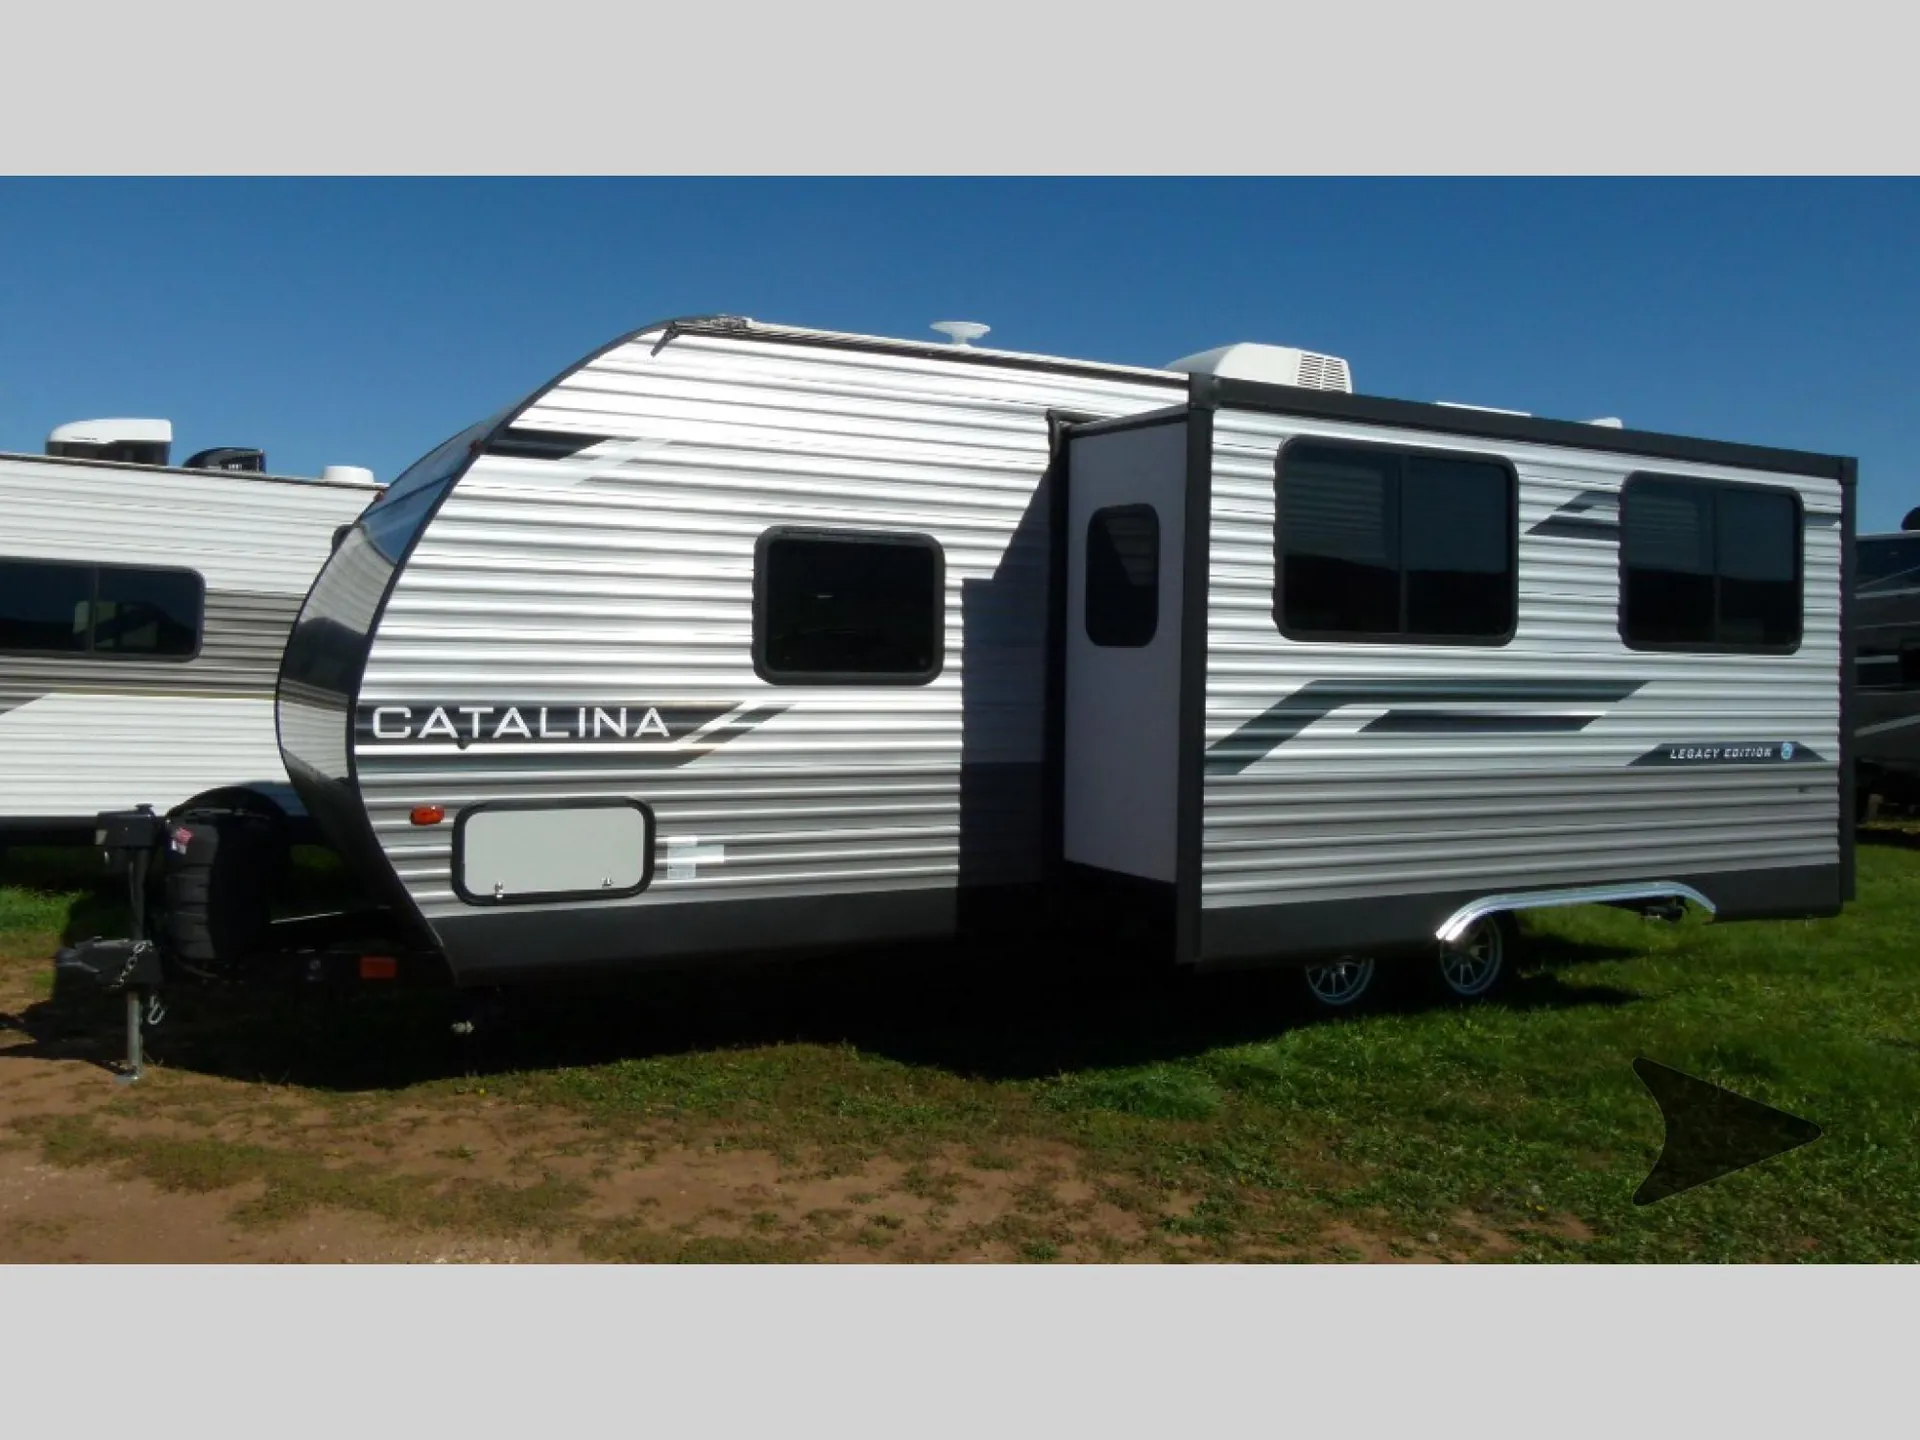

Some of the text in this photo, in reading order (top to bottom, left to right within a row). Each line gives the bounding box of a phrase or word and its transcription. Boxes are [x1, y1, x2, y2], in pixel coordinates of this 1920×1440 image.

[371, 706, 671, 739] CATALINA
[1669, 746, 1773, 760] LEGACY EDITION
